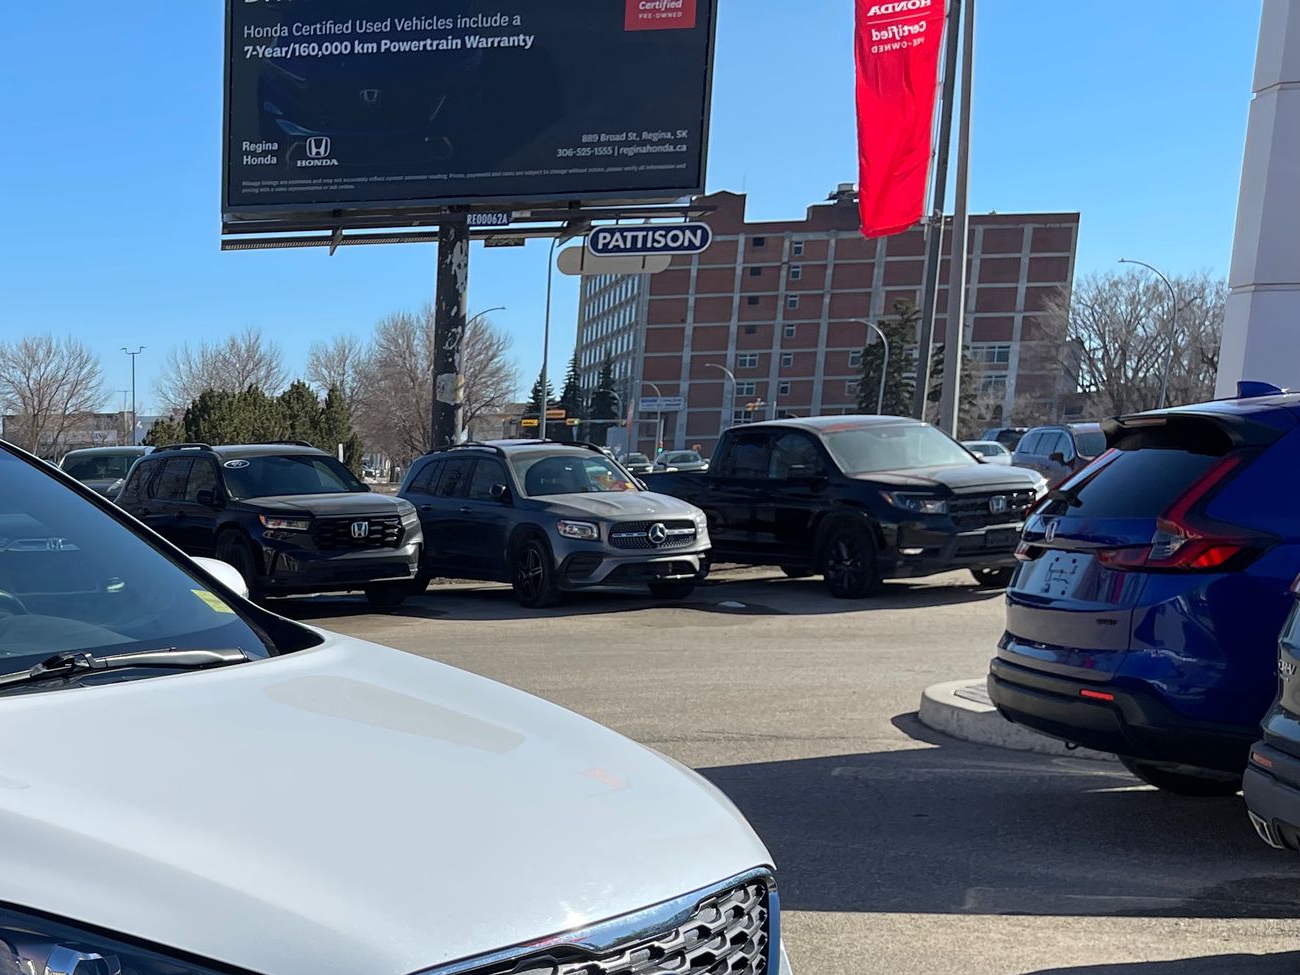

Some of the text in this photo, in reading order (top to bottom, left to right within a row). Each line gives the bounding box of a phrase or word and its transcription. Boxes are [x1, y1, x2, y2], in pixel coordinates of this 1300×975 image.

[639, 0, 683, 11] Certified
[243, 12, 522, 38] Honda Certified Used Vehicles include a
[243, 33, 534, 59] 7-Year/160,000 km Powertrain Warranty
[676, 130, 688, 139] SK
[242, 140, 278, 153] Regina
[619, 142, 687, 157] reginahonda.ca
[243, 154, 277, 165] Honda
[296, 158, 339, 167] HONDA
[597, 229, 702, 250] PATTISON
